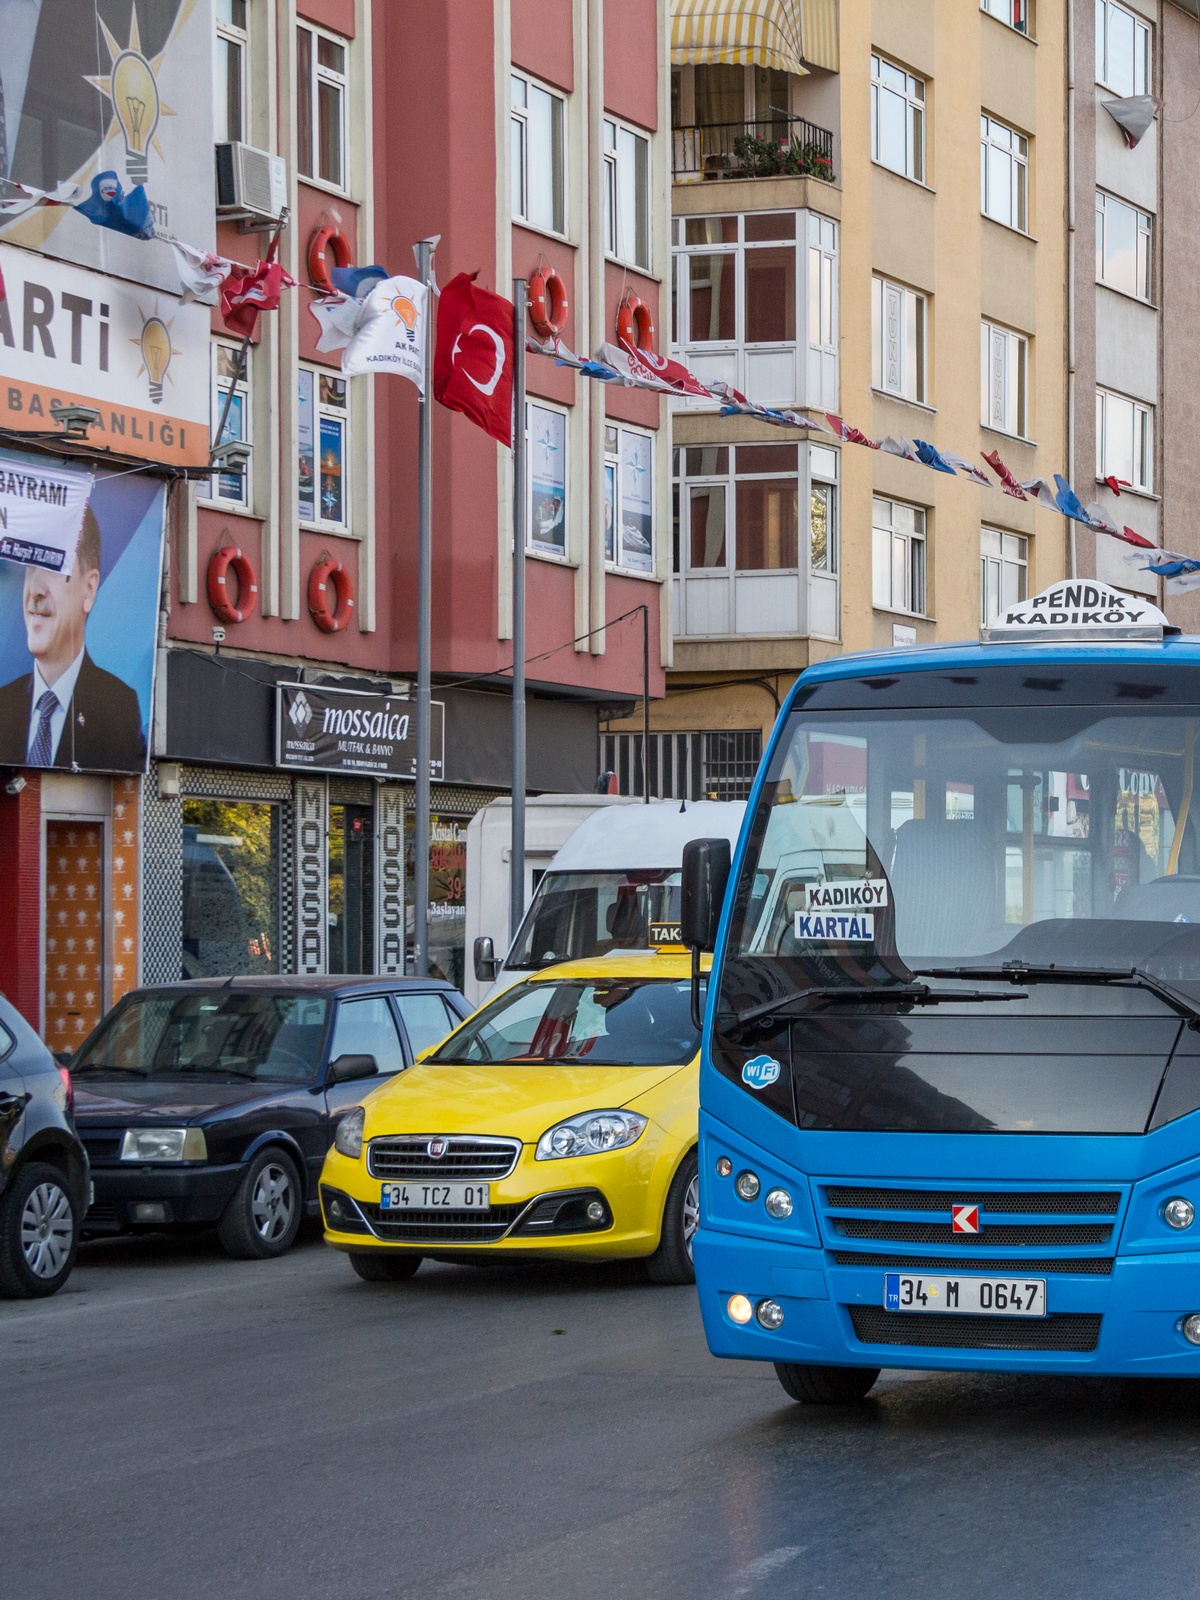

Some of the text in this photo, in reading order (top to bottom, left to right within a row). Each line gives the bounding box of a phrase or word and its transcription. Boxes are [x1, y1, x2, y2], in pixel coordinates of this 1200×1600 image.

[366, 353, 401, 364] KADIKÖY
[8, 387, 186, 450] BAŞANLIĞI
[1006, 609, 1146, 625] KADIKÖY
[322, 702, 410, 741] mossaica
[338, 740, 393, 756] MUTFAK & BANYO
[446, 877, 462, 899] 39
[810, 883, 884, 906] KADIKÖY
[799, 916, 872, 939] KARTAL
[391, 1187, 484, 1206] 34 TCZ 01
[888, 1294, 899, 1303] TR
[901, 1279, 1039, 1311] 34 M 0647
